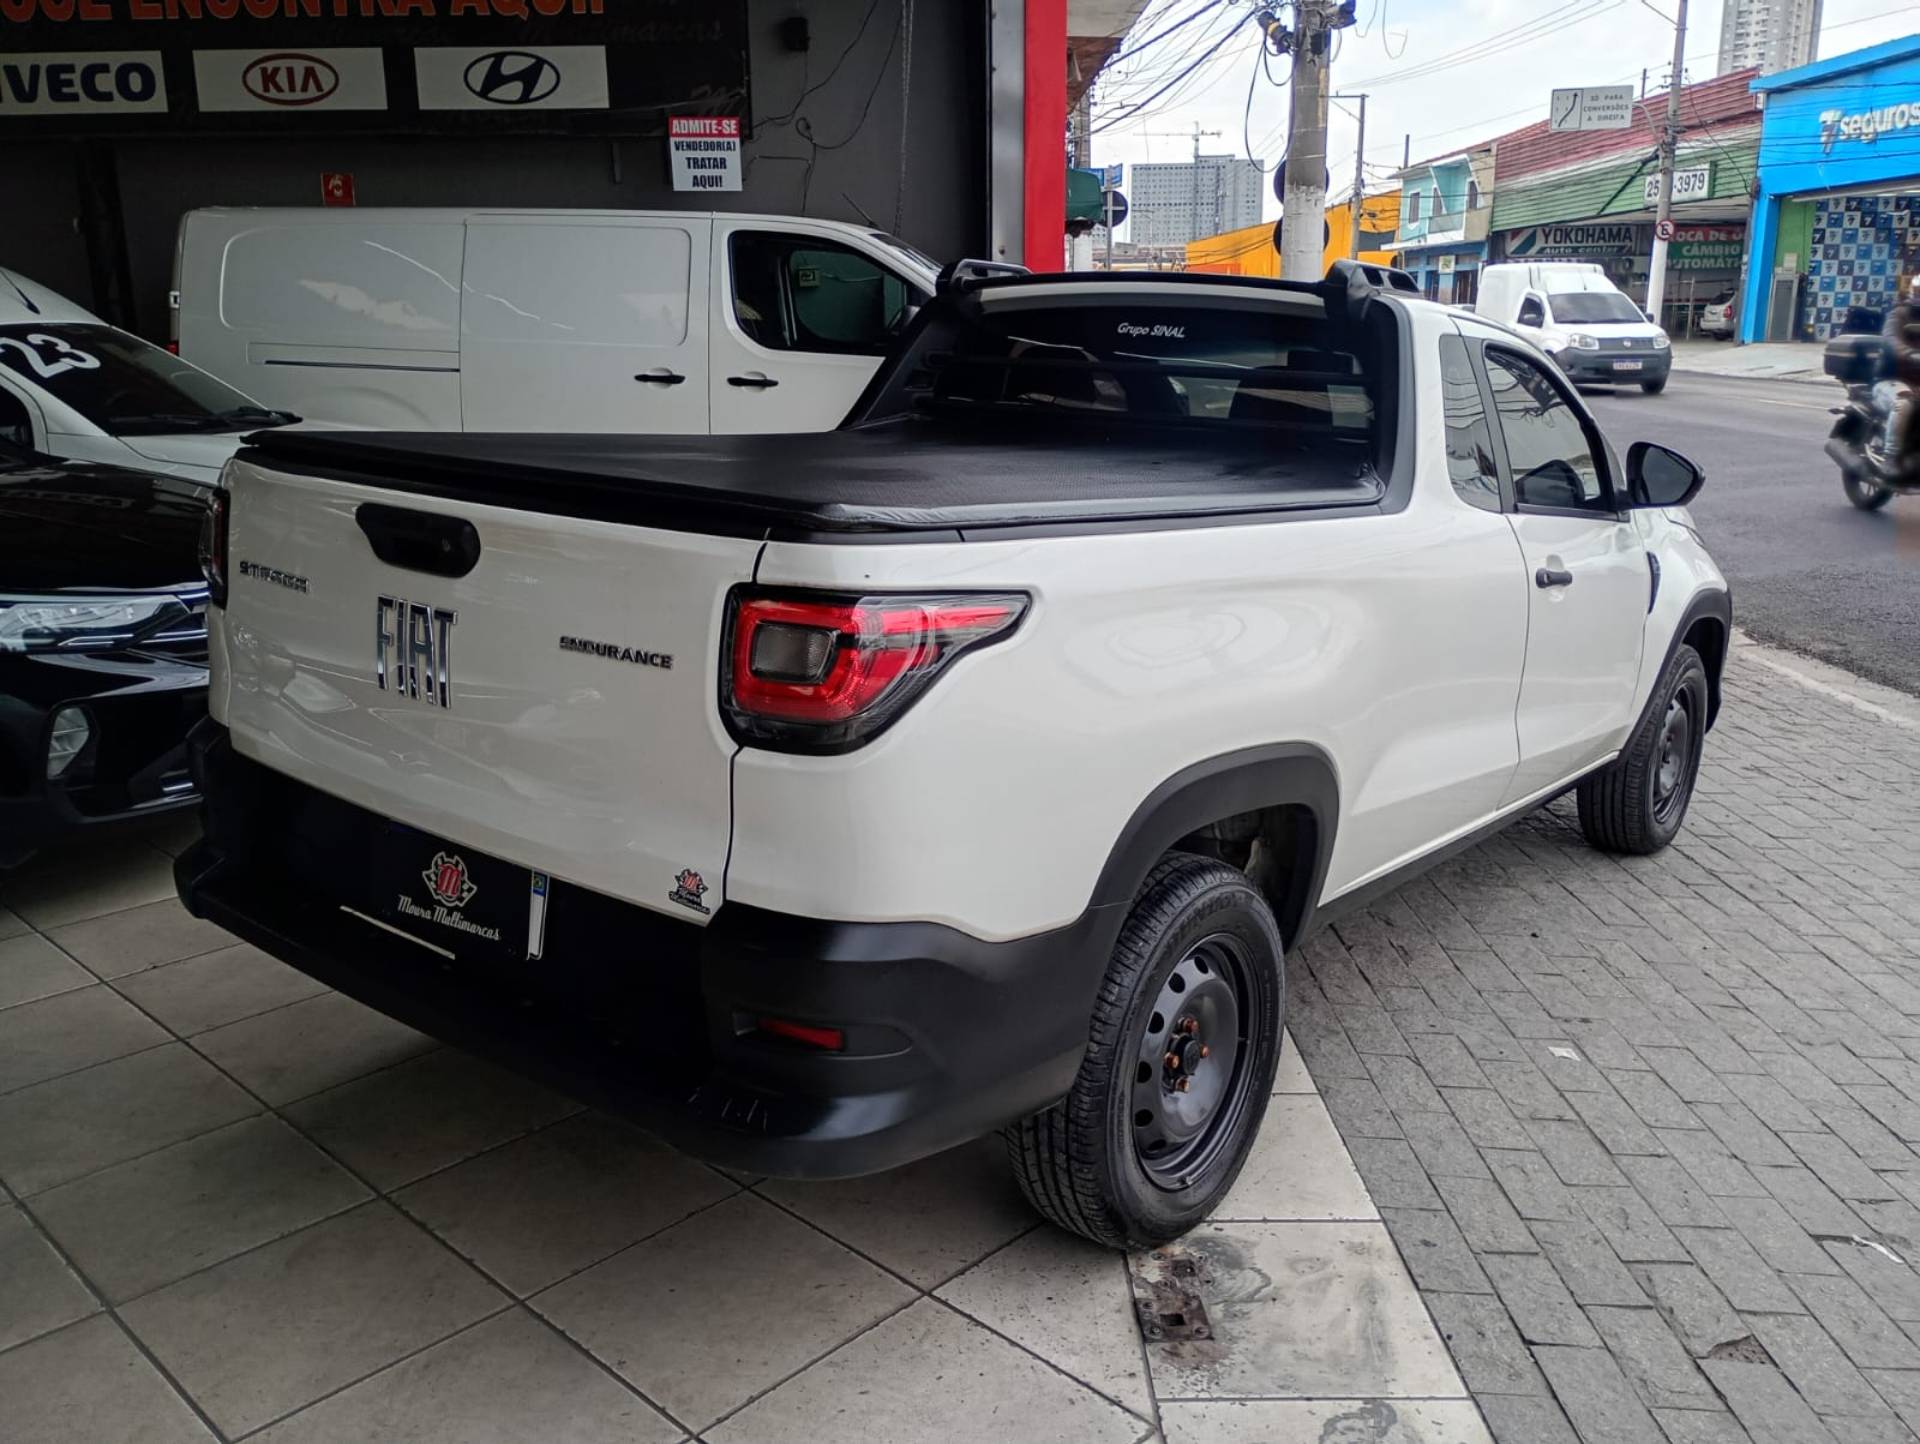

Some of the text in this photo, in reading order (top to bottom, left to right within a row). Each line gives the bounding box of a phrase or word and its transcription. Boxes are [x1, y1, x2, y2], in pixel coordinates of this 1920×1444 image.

[0, 62, 157, 103] VECO
[260, 66, 324, 93] KIA
[671, 119, 738, 134] ADMITE-SE
[674, 141, 736, 152] VENDEDOR(A)
[685, 157, 727, 170] TRATAR
[692, 175, 723, 189] AQUI!
[1542, 226, 1633, 244] YOKOHAMA
[1117, 322, 1185, 338] Grupo SINAL
[376, 594, 459, 709] FIAT
[560, 635, 673, 670] ENDURANCE
